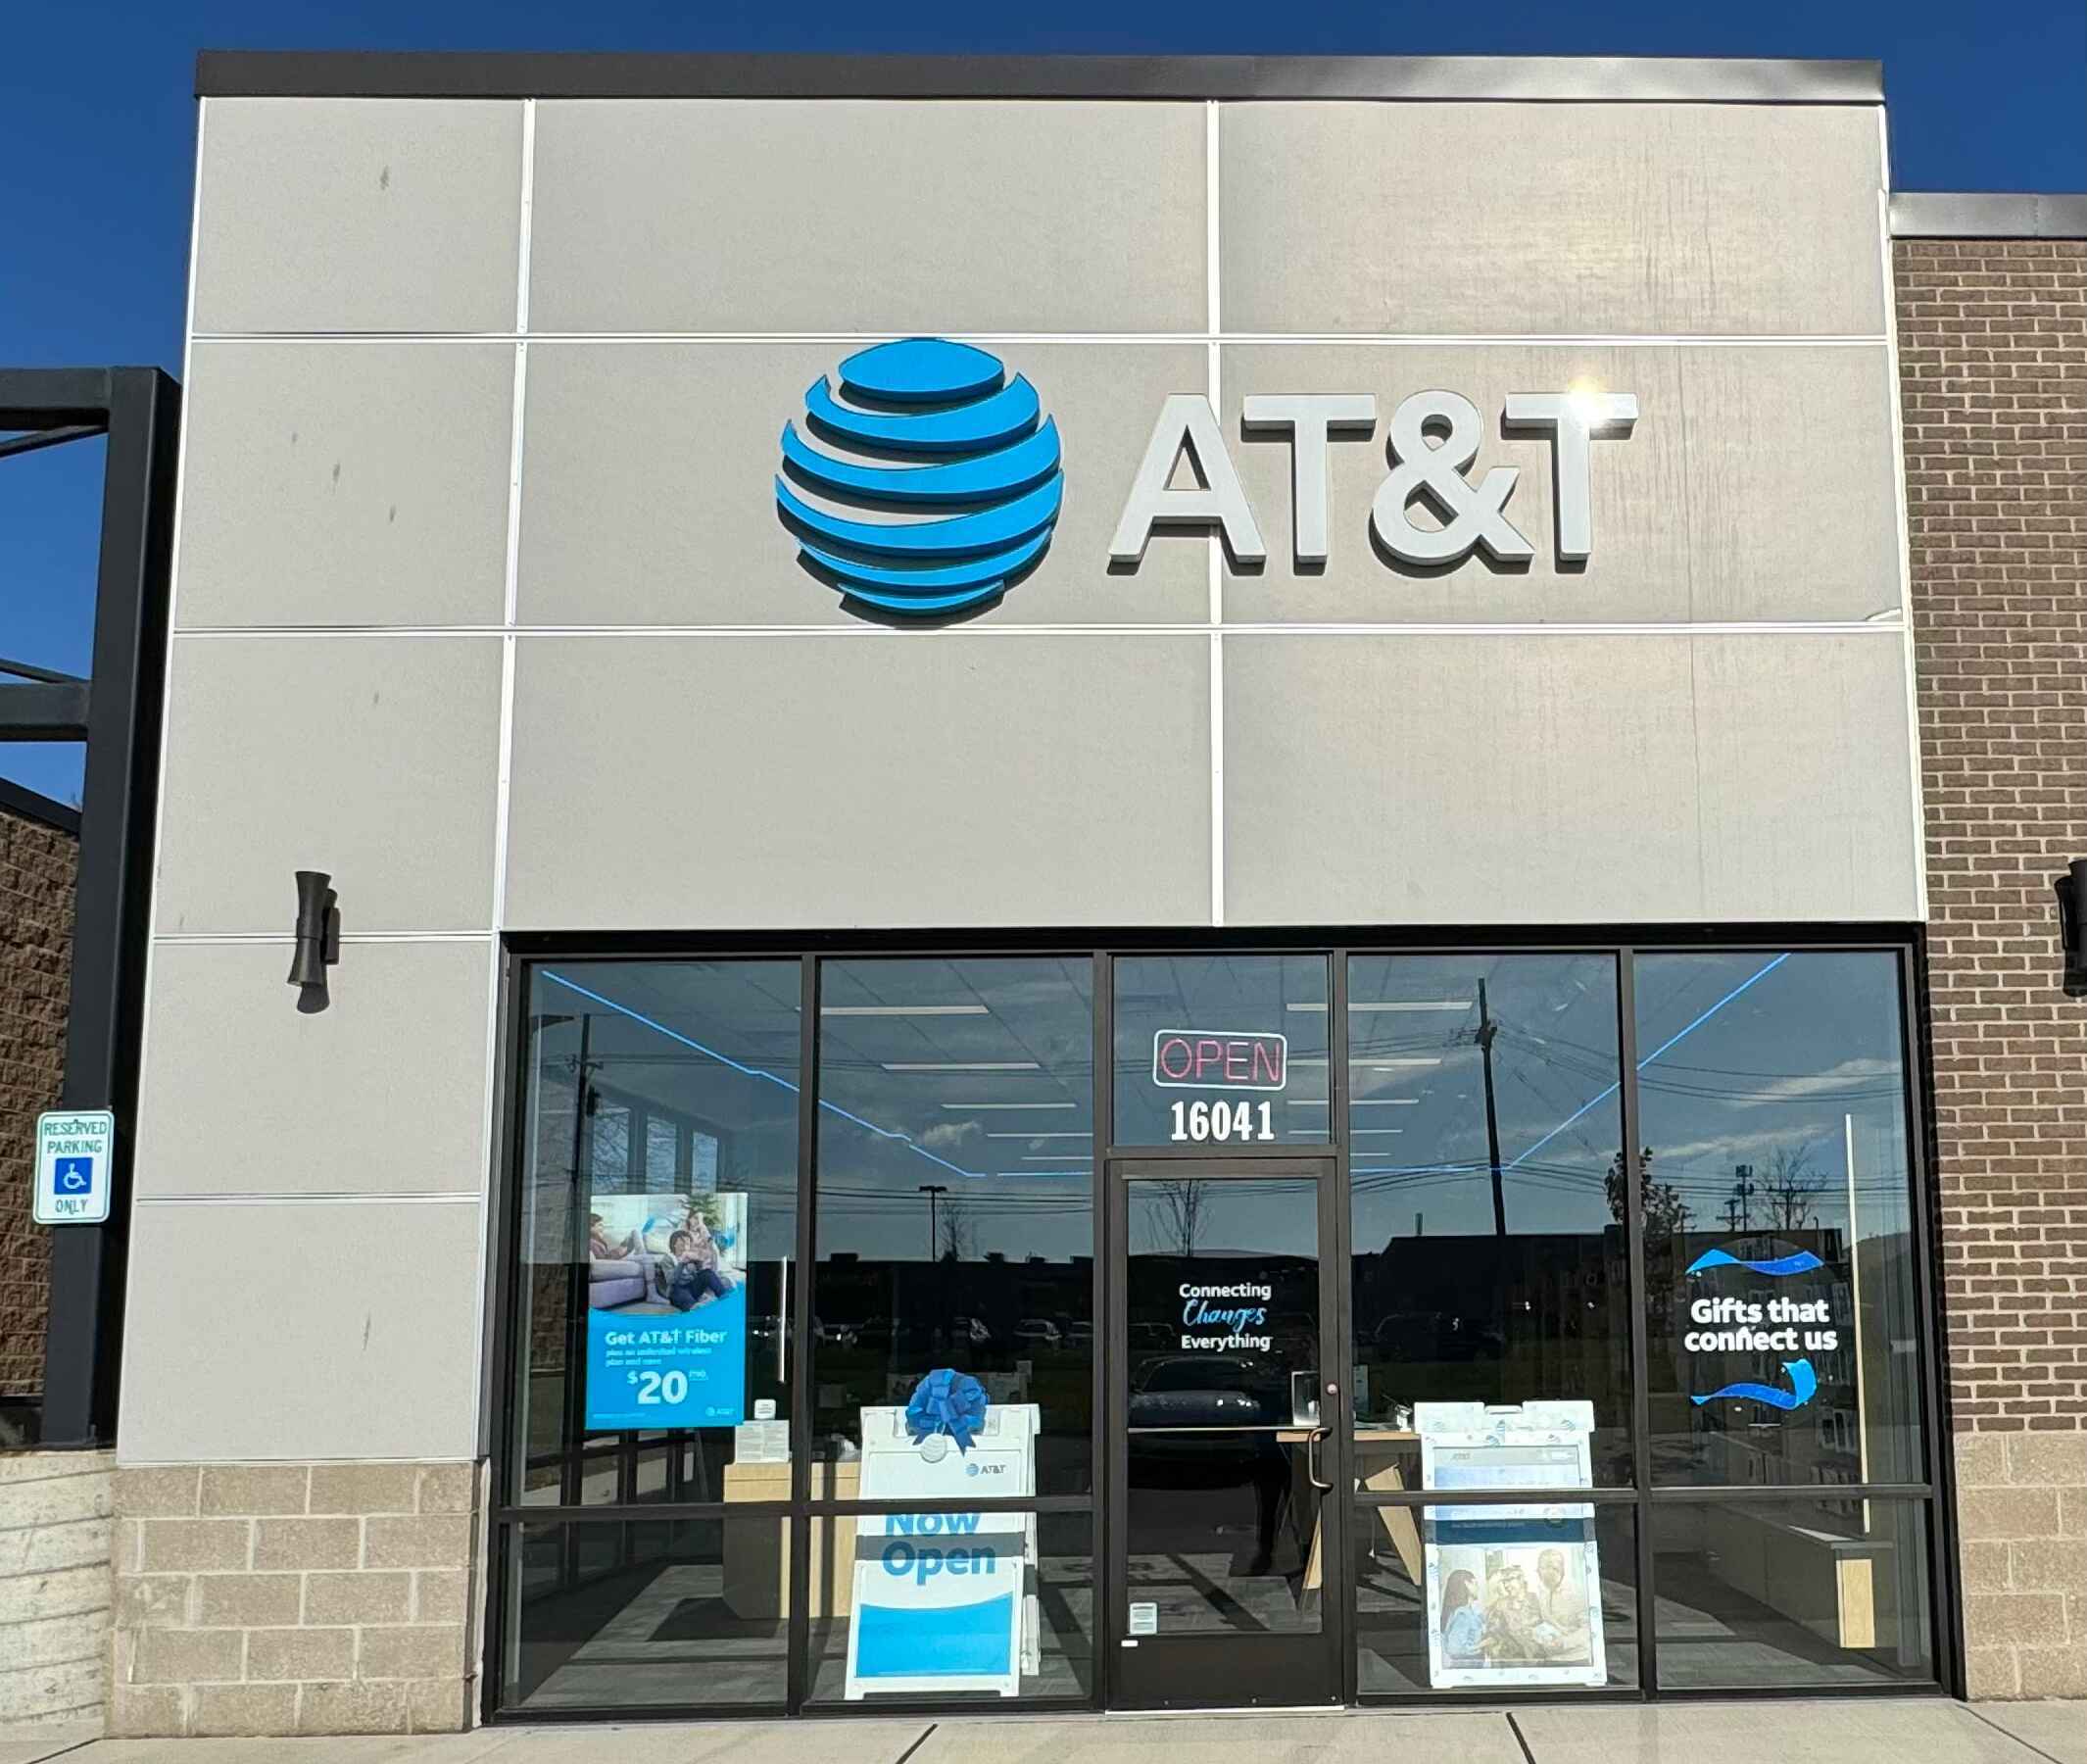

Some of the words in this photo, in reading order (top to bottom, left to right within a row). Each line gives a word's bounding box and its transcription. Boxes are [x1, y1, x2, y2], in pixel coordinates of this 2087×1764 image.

[1108, 389, 1639, 570] AT&T
[1160, 1038, 1281, 1082] OPEN
[44, 1121, 108, 1136] RESERVED
[1171, 1100, 1275, 1142] 16041
[47, 1140, 103, 1154] PARKING
[55, 1199, 89, 1213] ONLY
[1179, 1282, 1272, 1301] Connecting
[1183, 1298, 1268, 1333] Changes
[1690, 1297, 1764, 1324] Gifts
[1767, 1297, 1831, 1324] that
[605, 1331, 636, 1347] Get
[638, 1328, 683, 1345] AT&T
[686, 1329, 728, 1345] Fiber
[1181, 1333, 1272, 1352] Everything
[1684, 1326, 1800, 1351] connect
[1804, 1330, 1839, 1351] us
[627, 1370, 689, 1404] $20
[981, 1464, 1007, 1475] AT&T
[883, 1541, 996, 1586] Open
